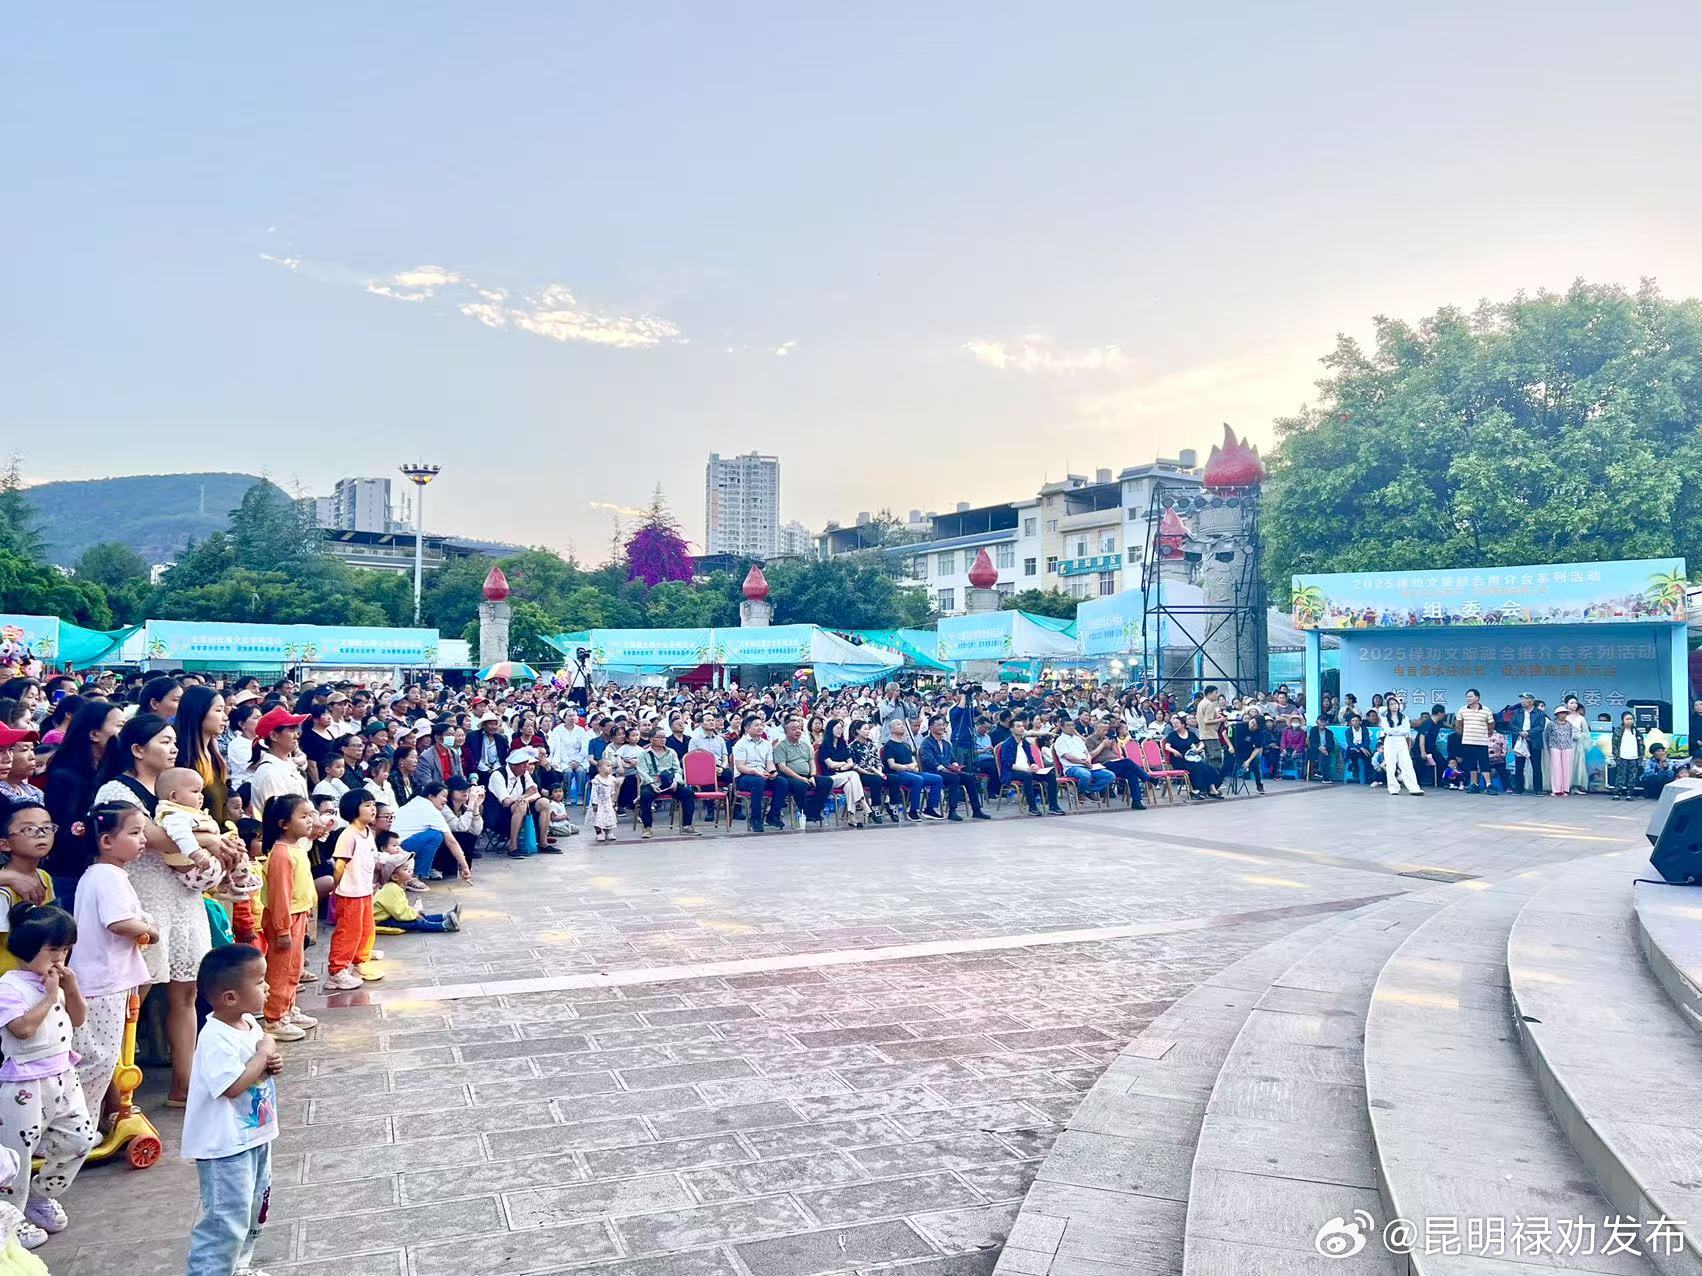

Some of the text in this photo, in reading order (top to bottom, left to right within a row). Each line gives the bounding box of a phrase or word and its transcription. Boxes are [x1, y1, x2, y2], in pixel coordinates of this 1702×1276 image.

[1422, 599, 1522, 619] 组委会
[1359, 644, 1656, 661] 2025禄劝文旅融合推介会系列活动
